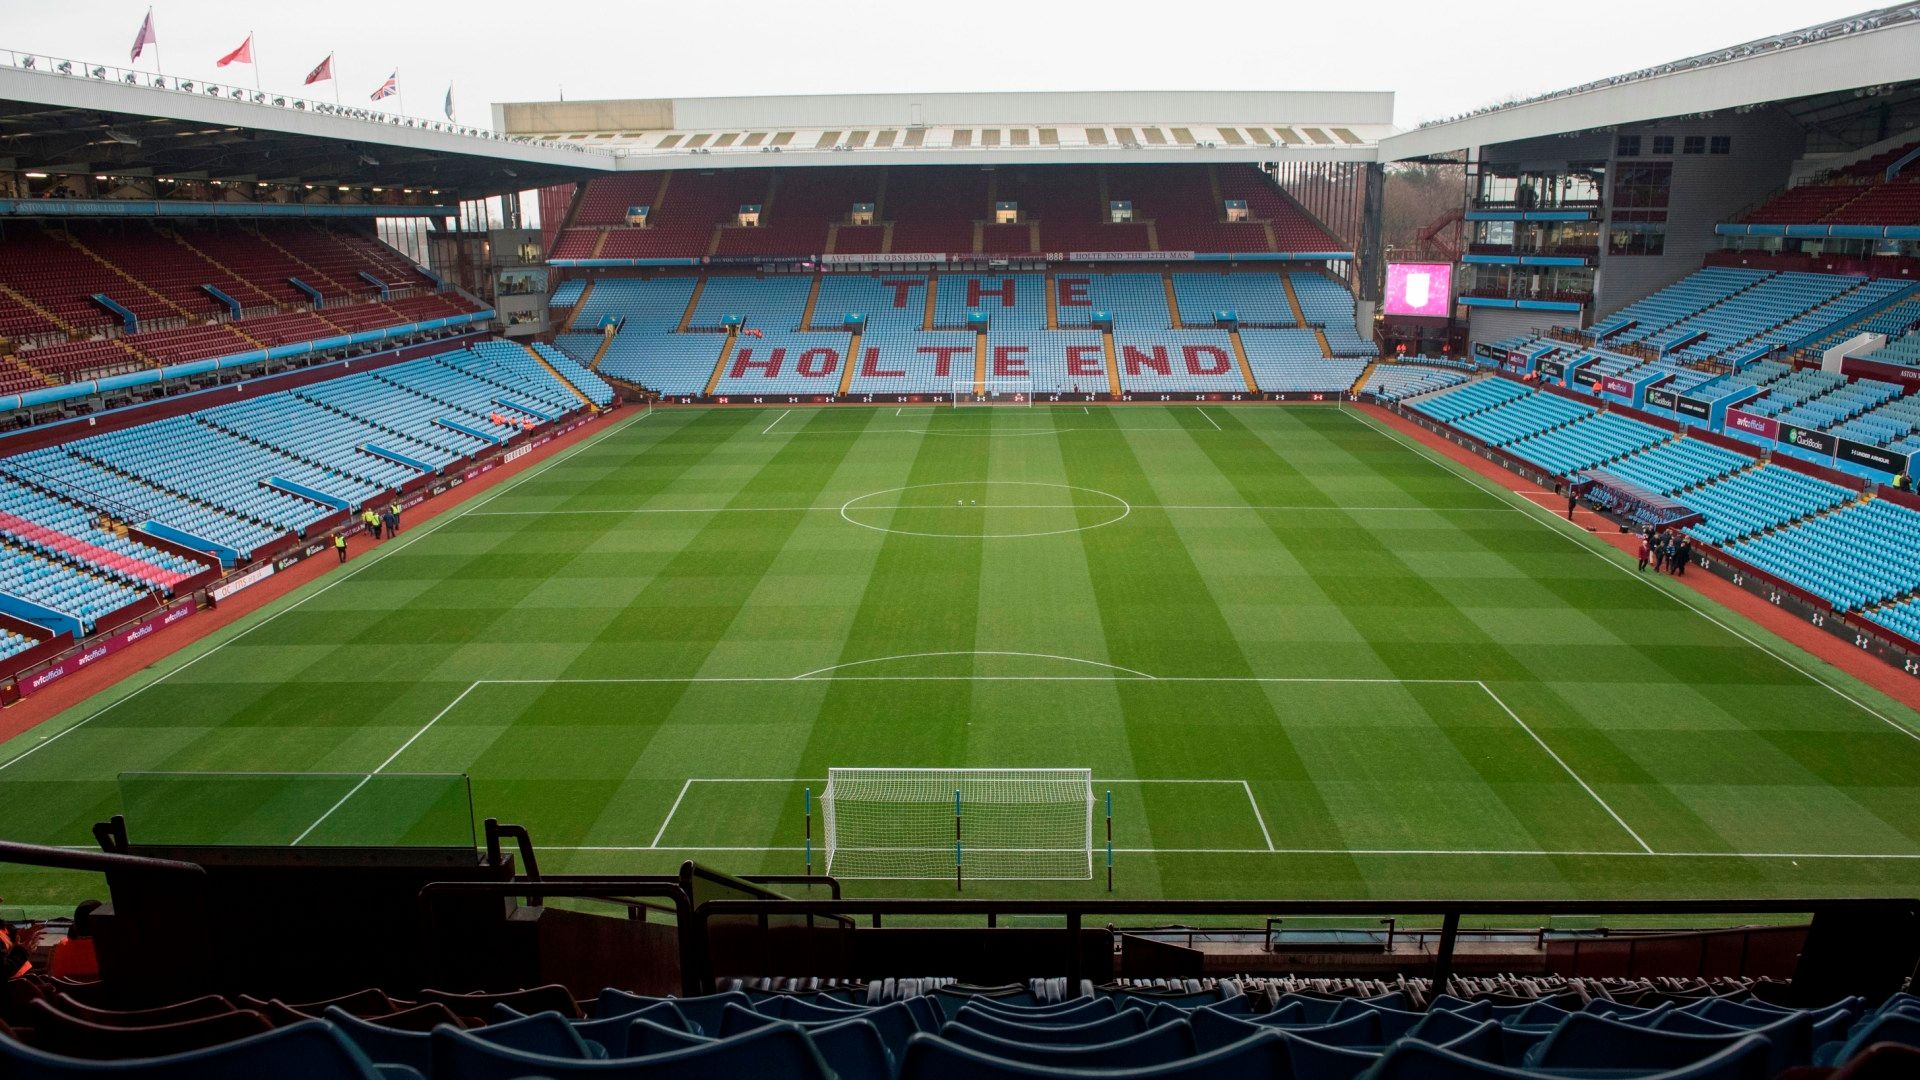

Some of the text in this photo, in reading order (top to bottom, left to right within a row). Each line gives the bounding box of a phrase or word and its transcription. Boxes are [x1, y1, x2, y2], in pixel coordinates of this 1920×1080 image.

[45, 203, 66, 211] VILLA
[861, 254, 883, 262] THE
[884, 253, 937, 262] OBSESSION
[1046, 252, 1064, 261] 1888
[881, 278, 1093, 308] THE
[729, 345, 1232, 378] HOLTE END
[1900, 370, 1917, 379] ASTON
[1736, 417, 1765, 432] avfcofficial
[1796, 435, 1823, 450] QuickBooks
[1857, 451, 1890, 465] UNDER ARMOUR
[164, 608, 188, 624] avfcofficial
[127, 624, 153, 642] avfcofficial
[78, 645, 107, 666] avfcofficial
[33, 666, 64, 687] avfcofficial
